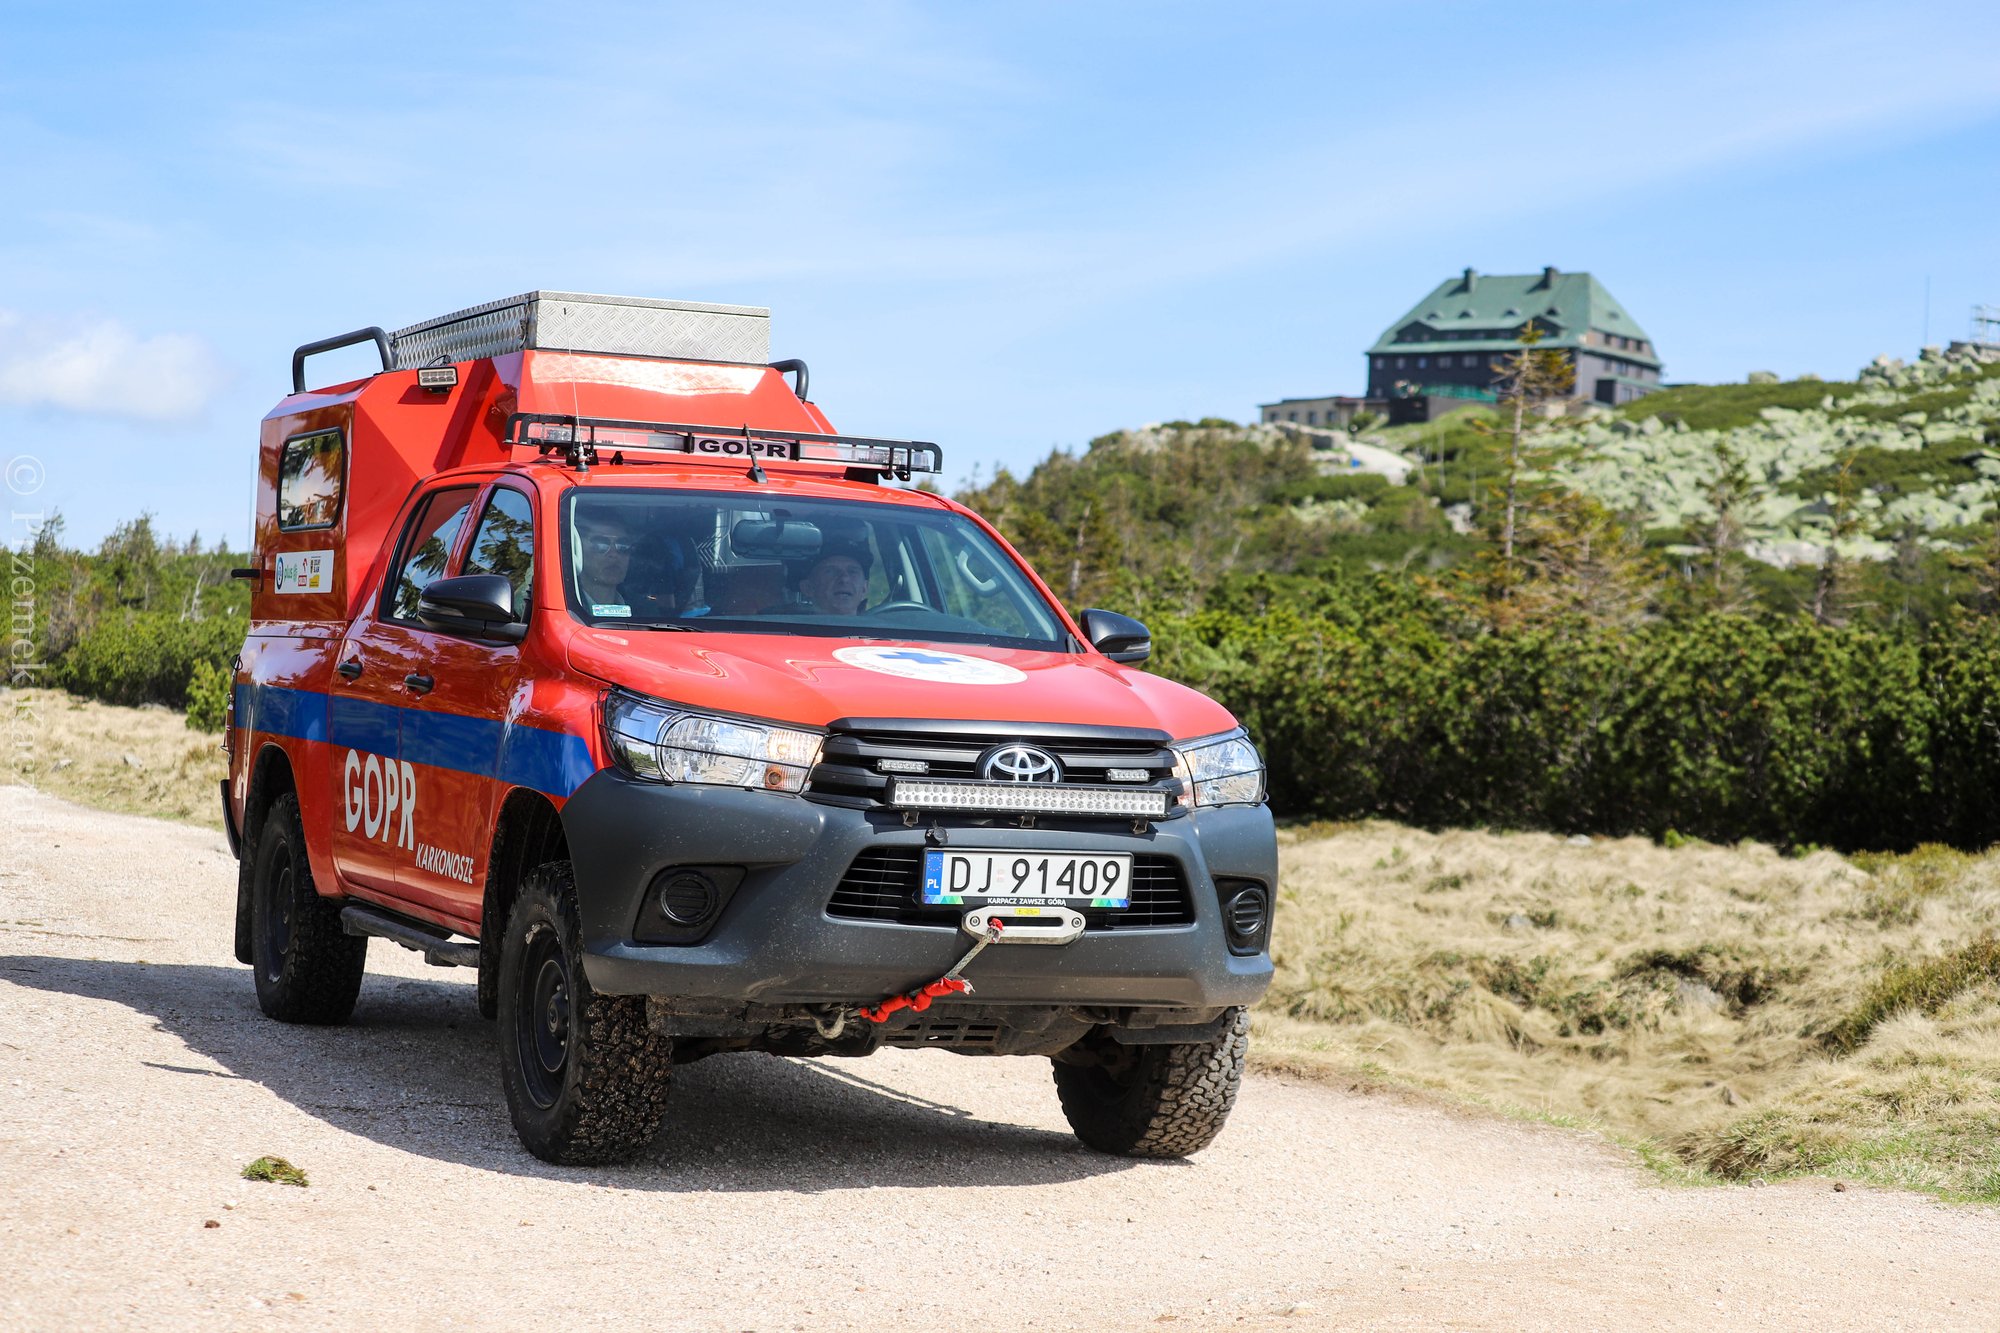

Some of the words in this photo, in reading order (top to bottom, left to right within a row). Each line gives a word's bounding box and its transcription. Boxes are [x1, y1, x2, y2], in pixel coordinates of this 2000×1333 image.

[698, 439, 787, 458] GOPR
[345, 748, 416, 851] GOPR
[415, 842, 474, 884] KARKONOSZE
[949, 856, 993, 893] DJ
[1011, 858, 1121, 895] 91409
[926, 878, 940, 889] PL
[987, 897, 1017, 905] KARPACZ
[1019, 897, 1046, 906] ZAWSZE
[1047, 897, 1067, 906] GÓRĄ
